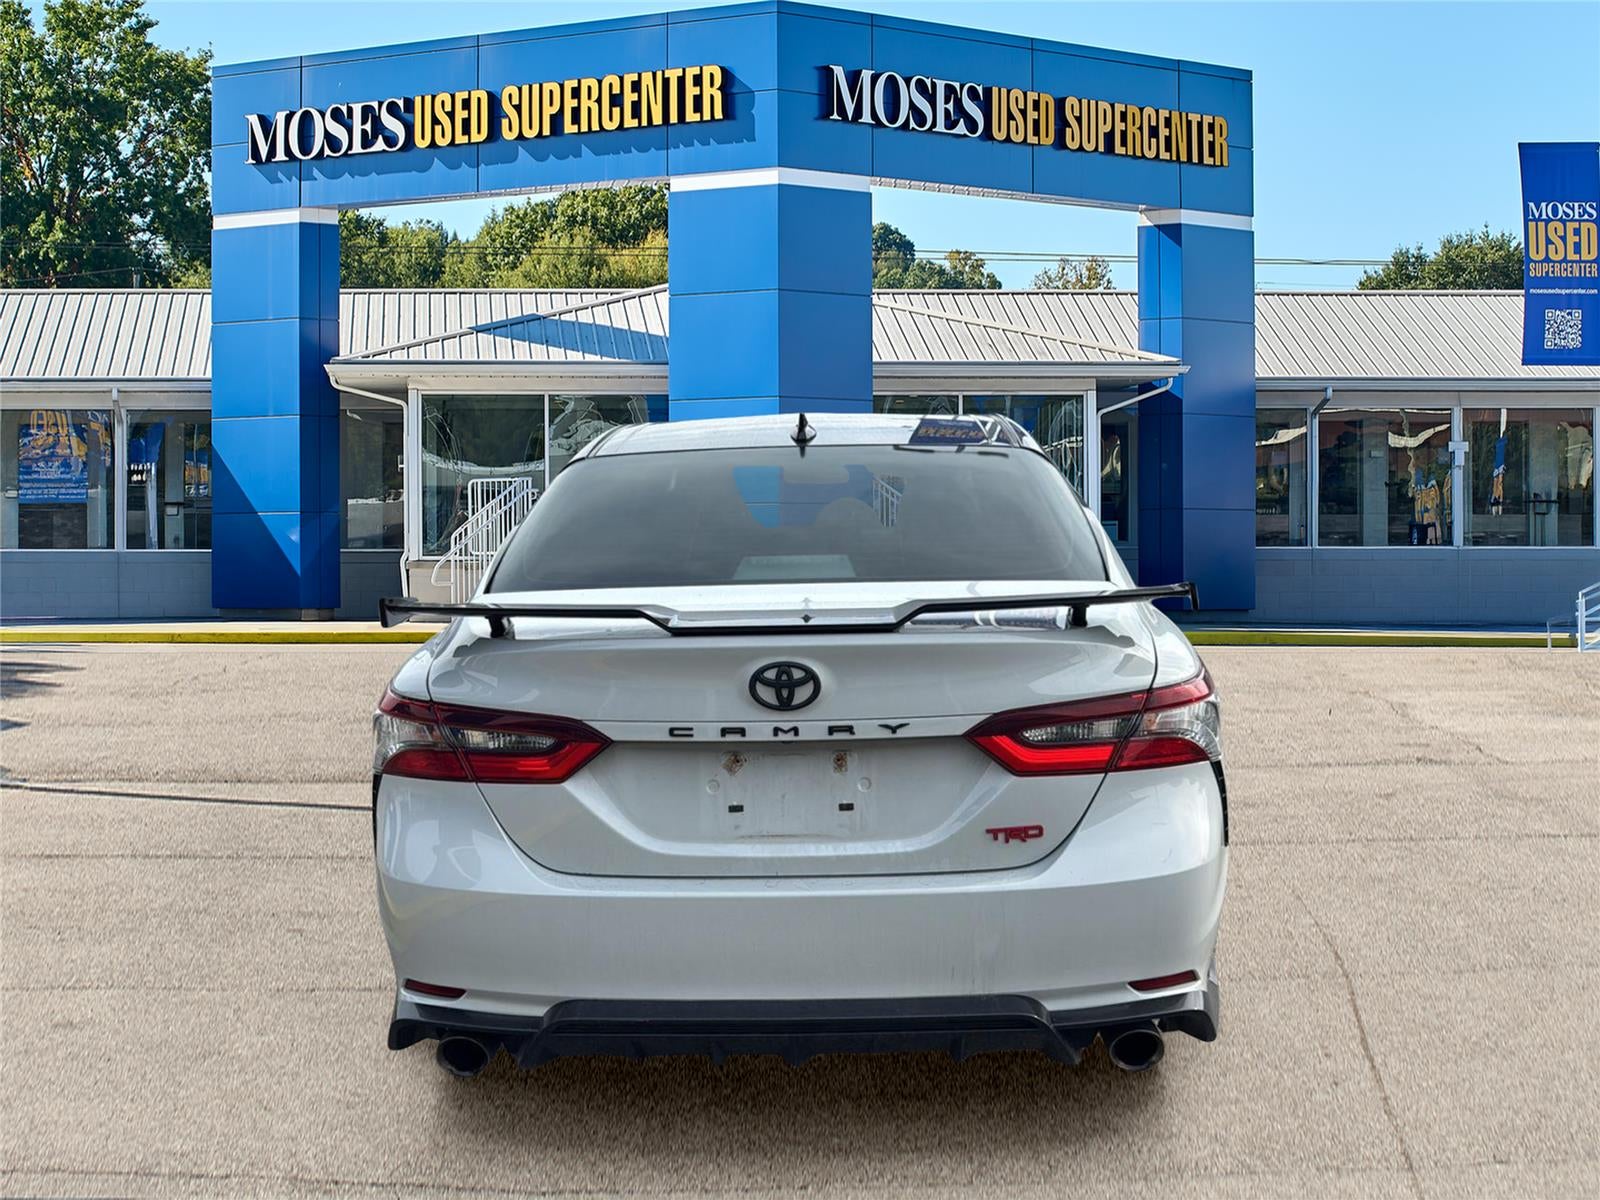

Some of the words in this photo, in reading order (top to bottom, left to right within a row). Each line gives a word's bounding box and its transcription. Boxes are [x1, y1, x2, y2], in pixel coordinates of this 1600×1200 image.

[244, 97, 407, 165] MOSES
[413, 88, 489, 150] USED
[500, 63, 725, 141] SUPERCENTER
[829, 64, 985, 138] MOSES
[991, 86, 1056, 146] USED
[1064, 95, 1230, 168] SUPERCENTER
[1527, 201, 1597, 220] MOSES
[1528, 220, 1598, 261] USED
[1529, 262, 1598, 278] SUPERCENTER
[668, 722, 911, 738] CAMRY
[985, 824, 1044, 844] TRD
